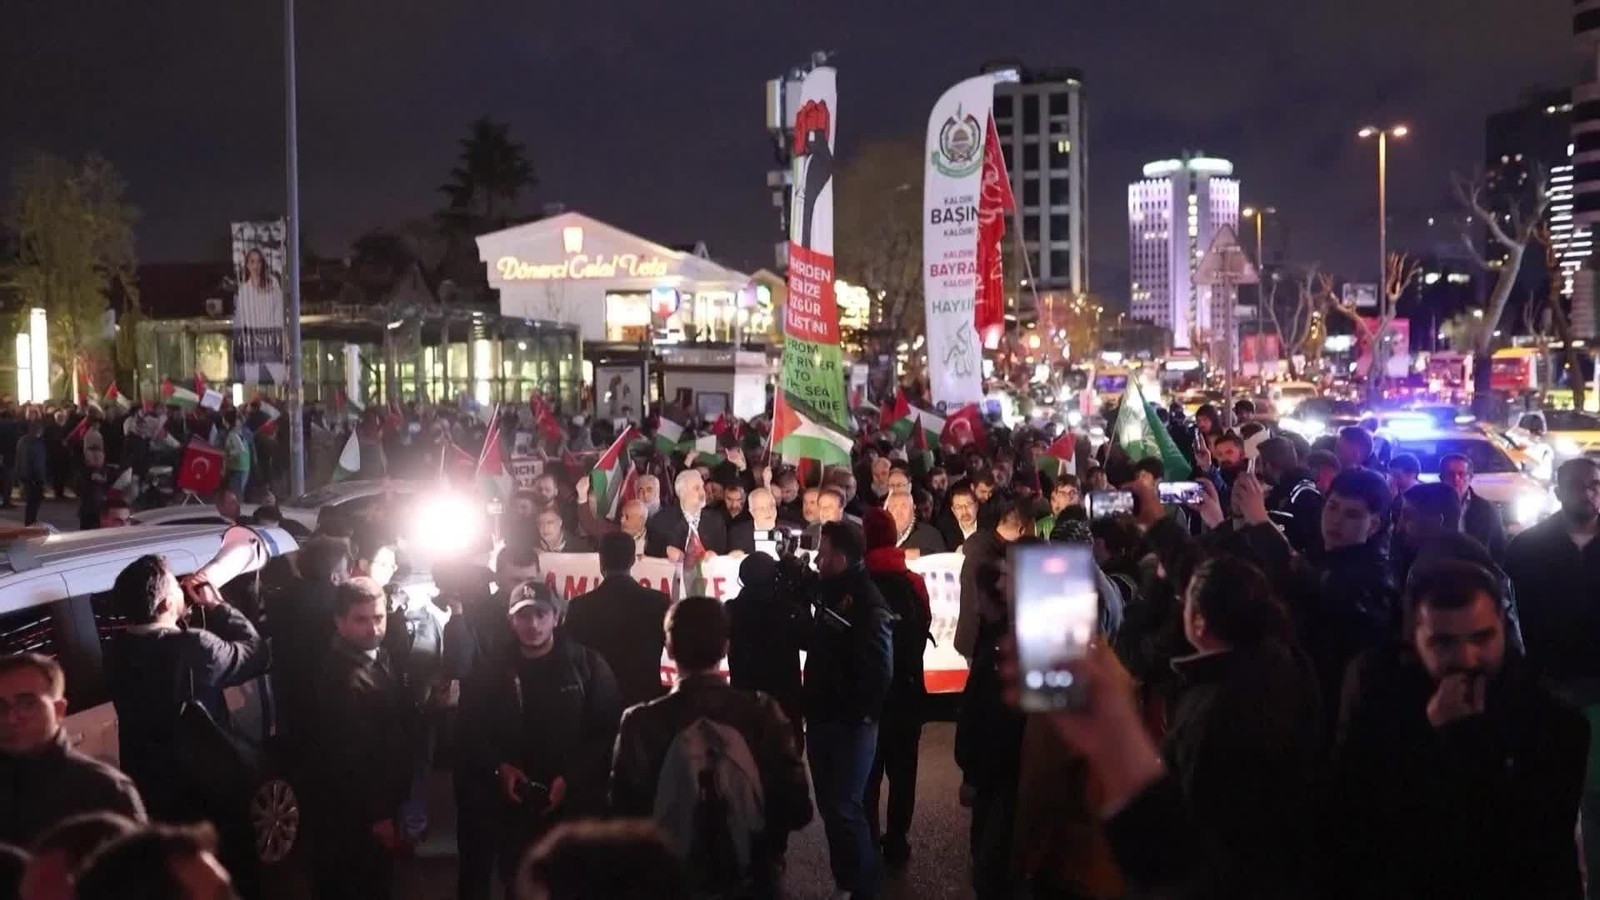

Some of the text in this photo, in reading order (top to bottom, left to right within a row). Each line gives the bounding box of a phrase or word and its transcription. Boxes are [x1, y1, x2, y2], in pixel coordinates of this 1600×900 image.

[931, 205, 978, 226] BAŞIN
[930, 262, 976, 277] BAYRA
[797, 356, 835, 371] RIVER
[794, 369, 811, 382] TO
[805, 386, 831, 398] SEA
